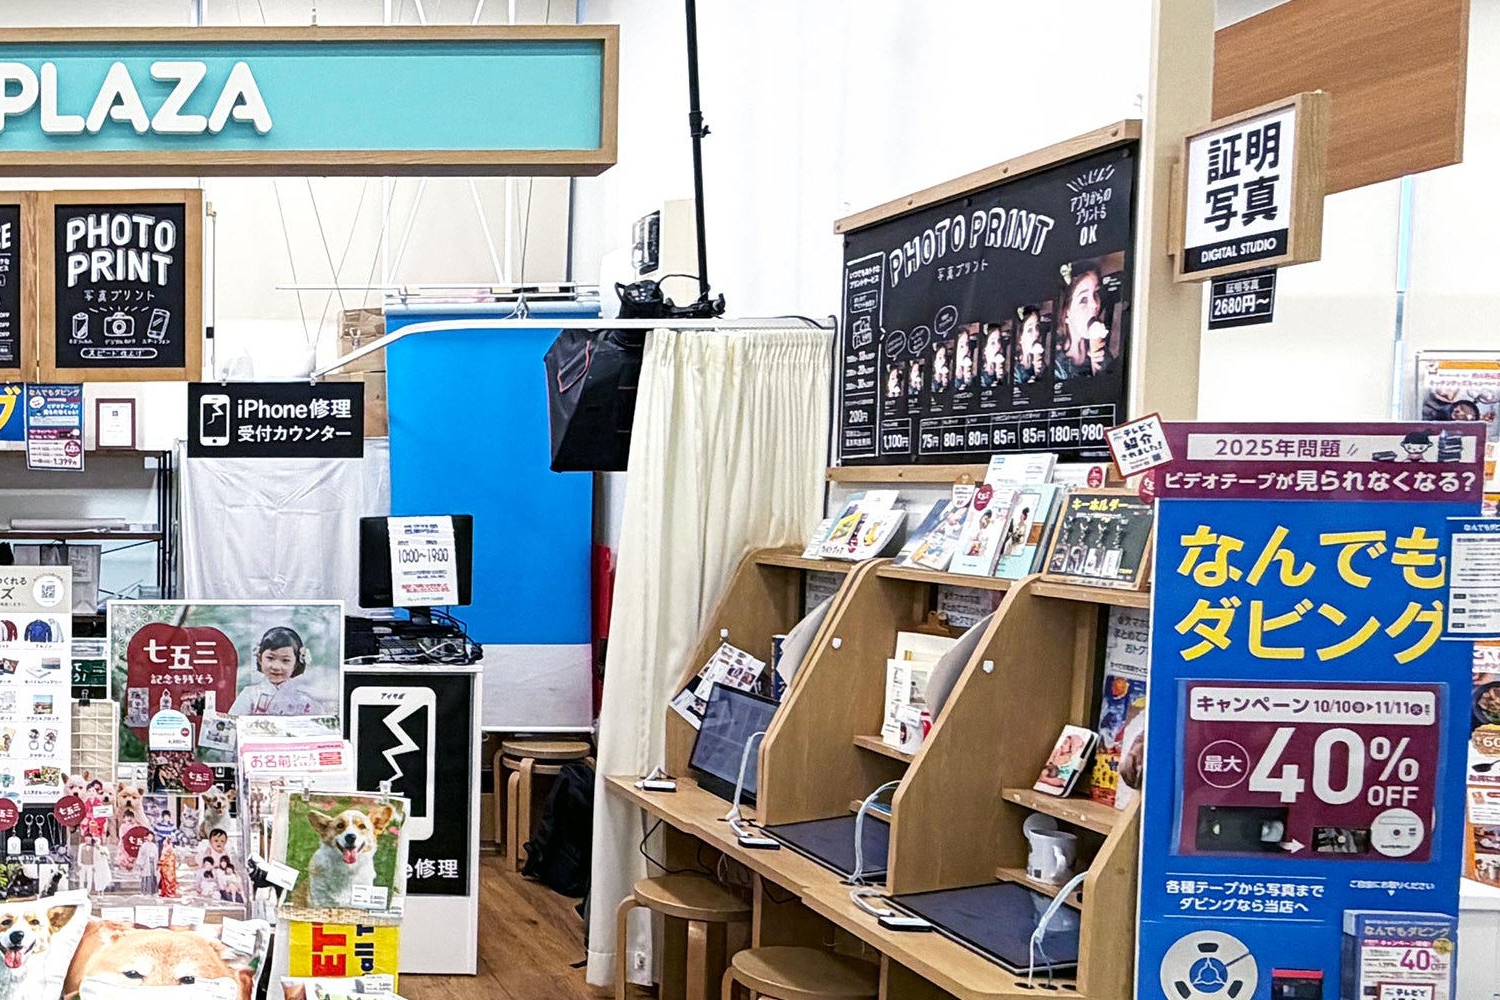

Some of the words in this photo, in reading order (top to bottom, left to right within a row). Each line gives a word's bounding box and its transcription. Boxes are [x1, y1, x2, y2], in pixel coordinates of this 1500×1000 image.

[1207, 121, 1282, 185] 証明
[1203, 174, 1281, 232] 写真
[66, 213, 177, 253] PHOTO
[1079, 224, 1098, 246] OK
[889, 214, 966, 288] PHOTO
[969, 207, 1055, 255] PRINT
[1201, 245, 1238, 263] DIGITAL
[1240, 237, 1277, 255] STUDIO
[67, 248, 174, 288] PRINT
[84, 289, 156, 302] 写真プリント
[237, 399, 352, 419] iPhone修理
[237, 425, 352, 442] 受付カウンター
[922, 433, 939, 448] 75円
[943, 432, 964, 447] 80円
[968, 430, 989, 446] 80円
[993, 429, 1016, 445] 85円
[1022, 427, 1046, 443] 85円
[1050, 425, 1080, 442] 180円
[1215, 438, 1341, 459] 2025年問題
[1165, 468, 1476, 493] ビデオテープが見られなくなる?
[1072, 497, 1129, 511] キーホルダー
[1177, 525, 1446, 589] なんでも
[1174, 597, 1445, 664] ダビング
[143, 639, 218, 670] 七五三
[150, 674, 214, 685] 記念を残そう
[1196, 697, 1310, 714] キャンペーン
[1313, 699, 1351, 714] 10/10
[1376, 701, 1410, 715] 11/11
[250, 755, 292, 769] お名前
[1203, 757, 1243, 774] 最大
[1248, 727, 1420, 805] 40%
[1367, 784, 1419, 807] OFF
[1165, 879, 1325, 898] 各種テープから写真まで
[1179, 898, 1309, 914] ダビングなら当店へ
[1364, 926, 1450, 937] なんでもダビング
